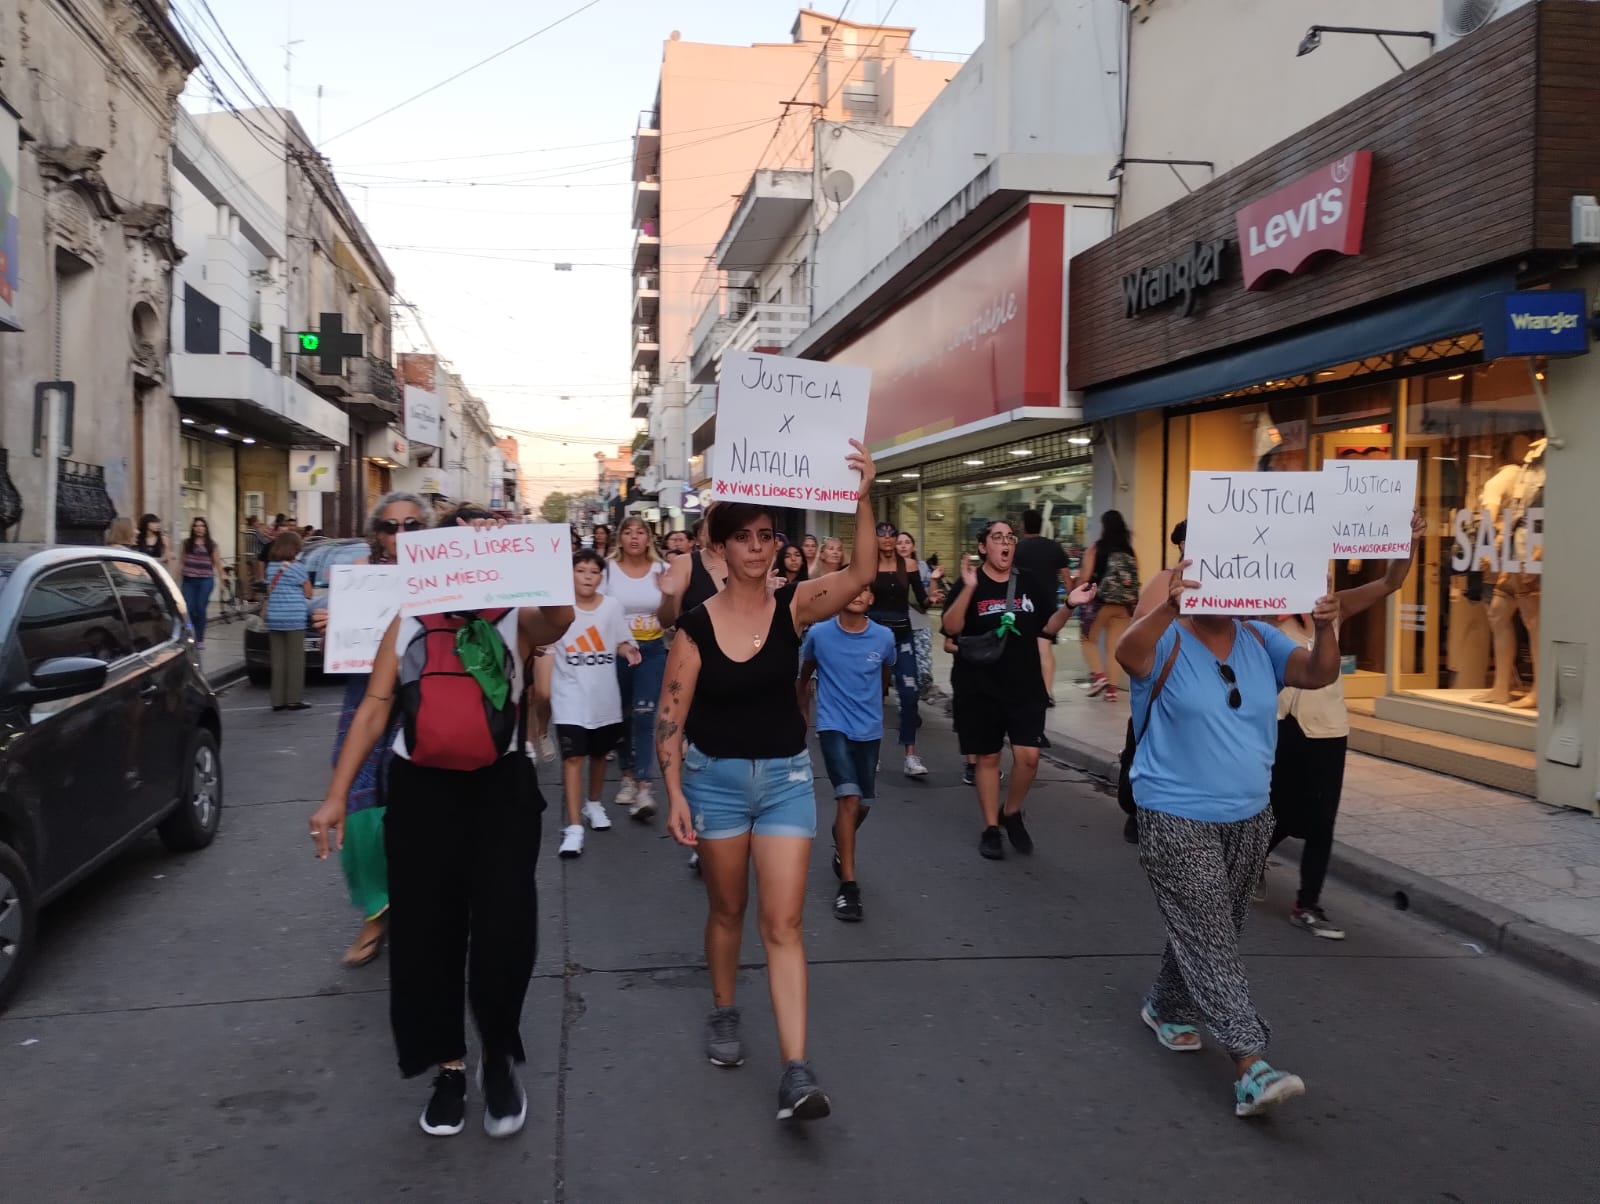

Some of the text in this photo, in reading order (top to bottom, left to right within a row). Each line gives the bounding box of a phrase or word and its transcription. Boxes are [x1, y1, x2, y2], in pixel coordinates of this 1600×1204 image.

[1121, 240, 1227, 319] Wrangler
[1510, 312, 1579, 334] Wrangler
[741, 357, 842, 402] JUSTICIA
[730, 437, 810, 478] NATALIA
[1207, 477, 1315, 515] JUSTICIA
[1335, 465, 1402, 496] JUSTICIA
[474, 536, 535, 556] LIBRES
[551, 536, 561, 553] Y
[1451, 508, 1544, 574] SALE
[1199, 553, 1297, 581] Natalia
[406, 575, 438, 595] SIN
